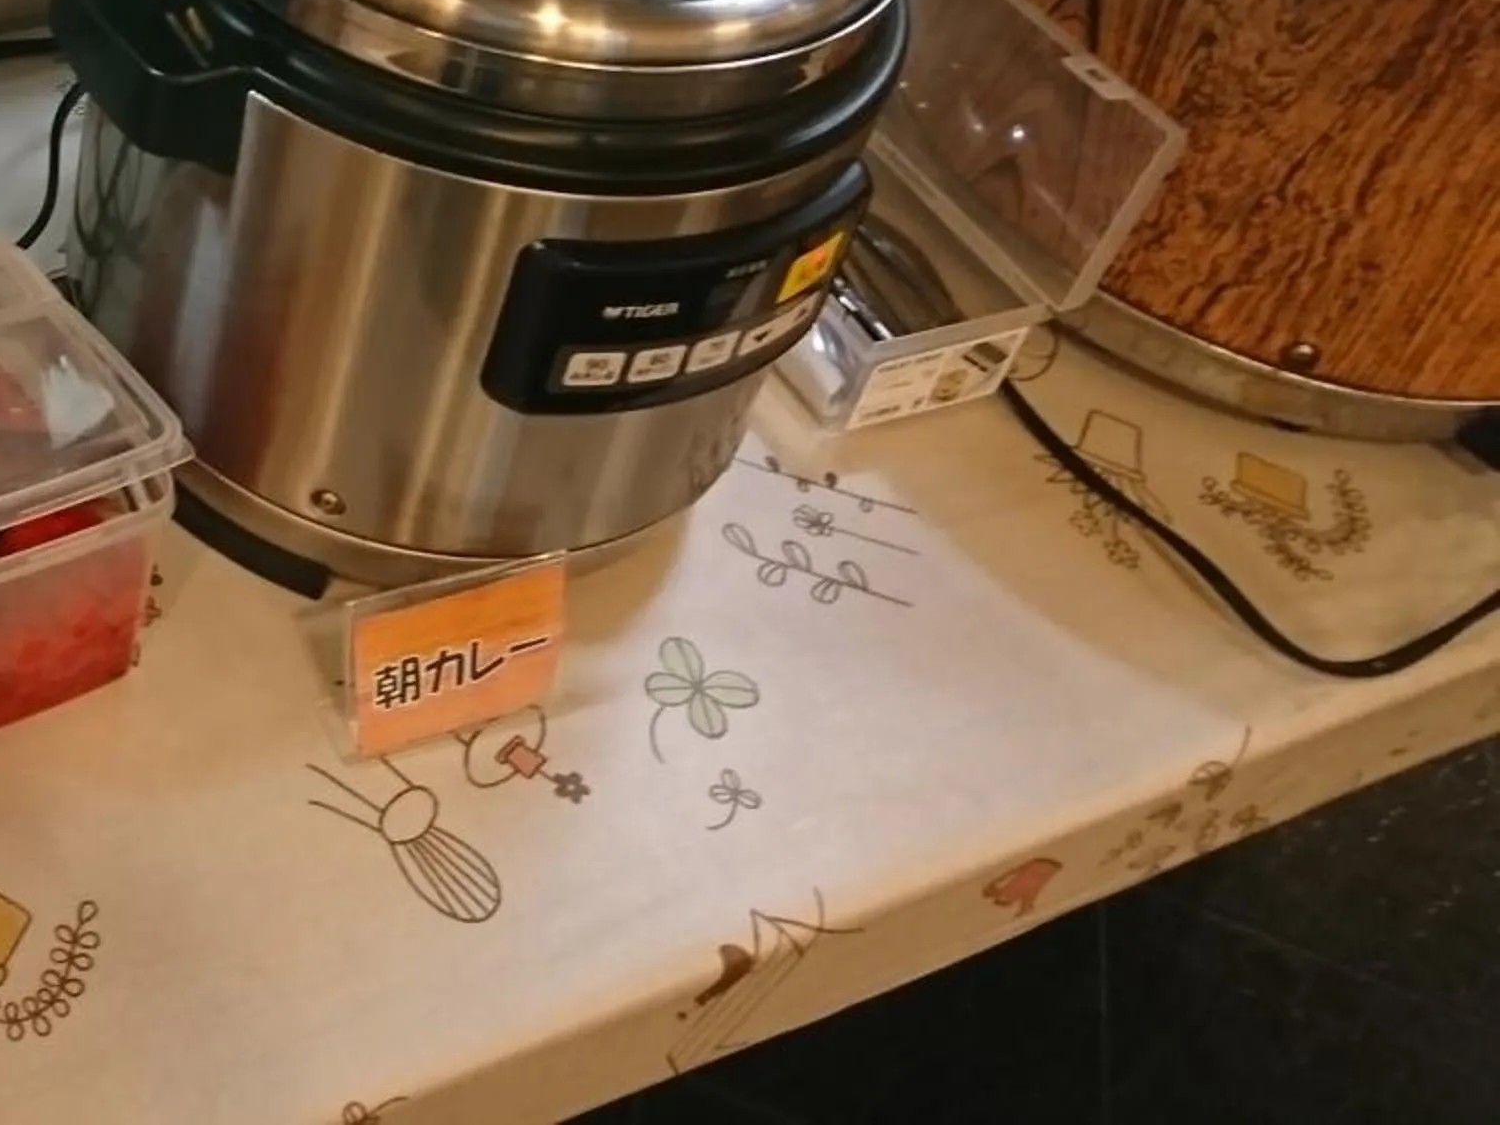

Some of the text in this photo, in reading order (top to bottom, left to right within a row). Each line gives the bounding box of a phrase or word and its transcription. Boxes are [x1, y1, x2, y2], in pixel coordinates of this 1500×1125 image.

[620, 302, 679, 318] TIGER
[375, 636, 549, 710] 朝カレー
